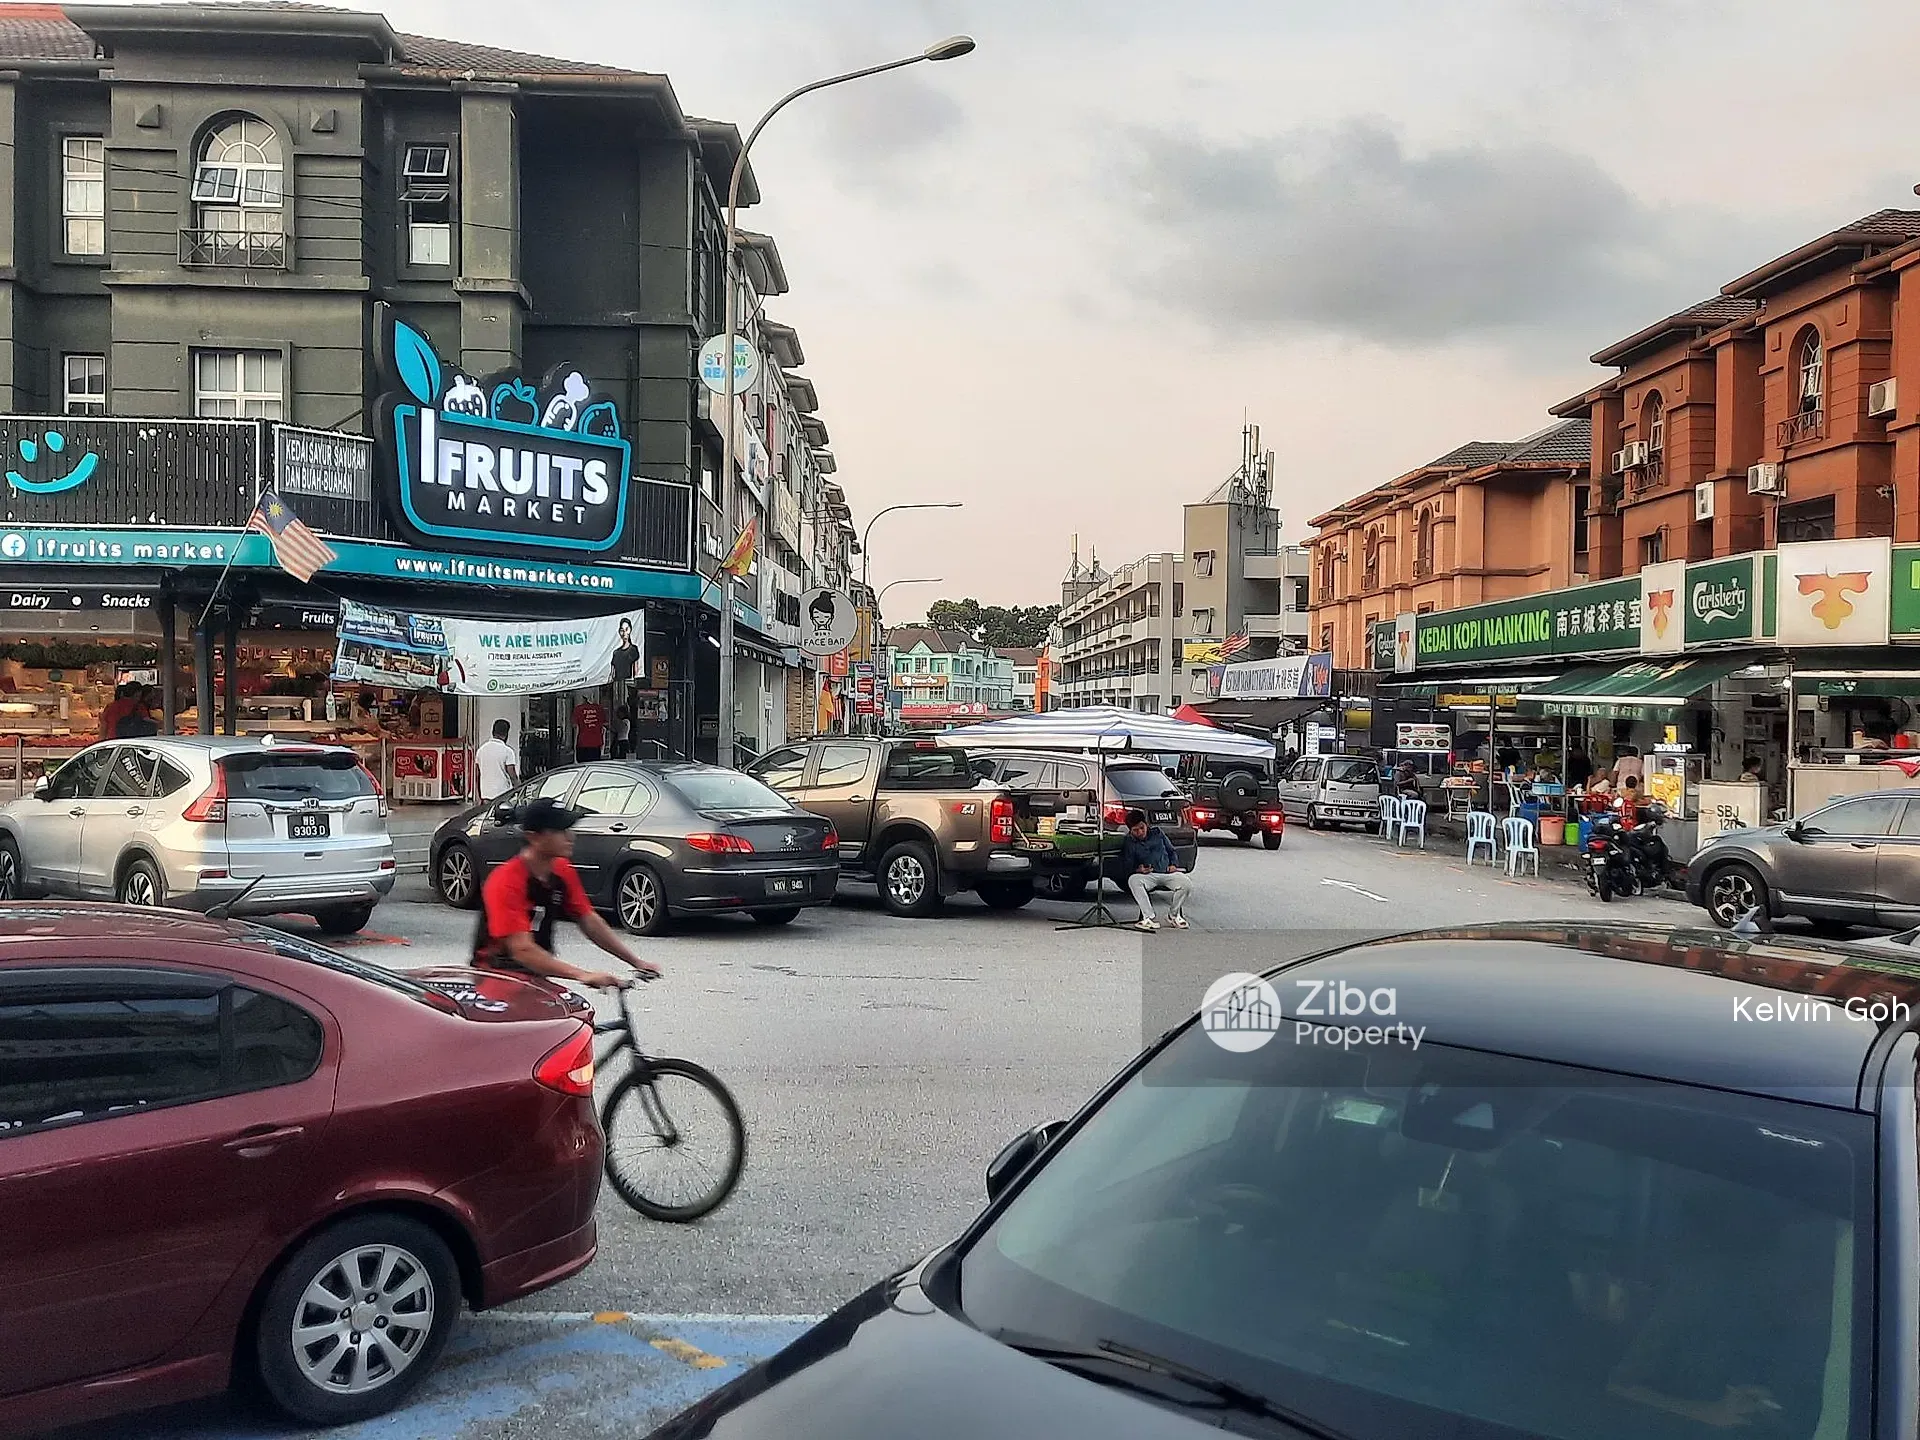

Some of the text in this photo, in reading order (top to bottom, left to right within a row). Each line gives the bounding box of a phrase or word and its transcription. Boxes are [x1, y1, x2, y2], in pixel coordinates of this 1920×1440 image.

[286, 438, 366, 470] KEDAI SAYUR SAYURAN
[286, 465, 353, 495] DAN BUAH-BUAHAN
[447, 491, 586, 525] MARKET
[134, 542, 225, 560] market
[396, 557, 614, 589] www.ifruitsmarket.com
[10, 593, 150, 609] Dairy Snacks
[1693, 577, 1747, 619] Carlsberg
[302, 611, 335, 625] Fruits
[479, 631, 588, 648] WE ARE HIRING!
[1418, 624, 1451, 654] KEDAI
[1453, 620, 1481, 650] KOPI
[1484, 609, 1550, 647] NANKING
[803, 637, 845, 647] FACE BAR
[1717, 804, 1739, 818] SBJ
[293, 825, 326, 837] 9303 D
